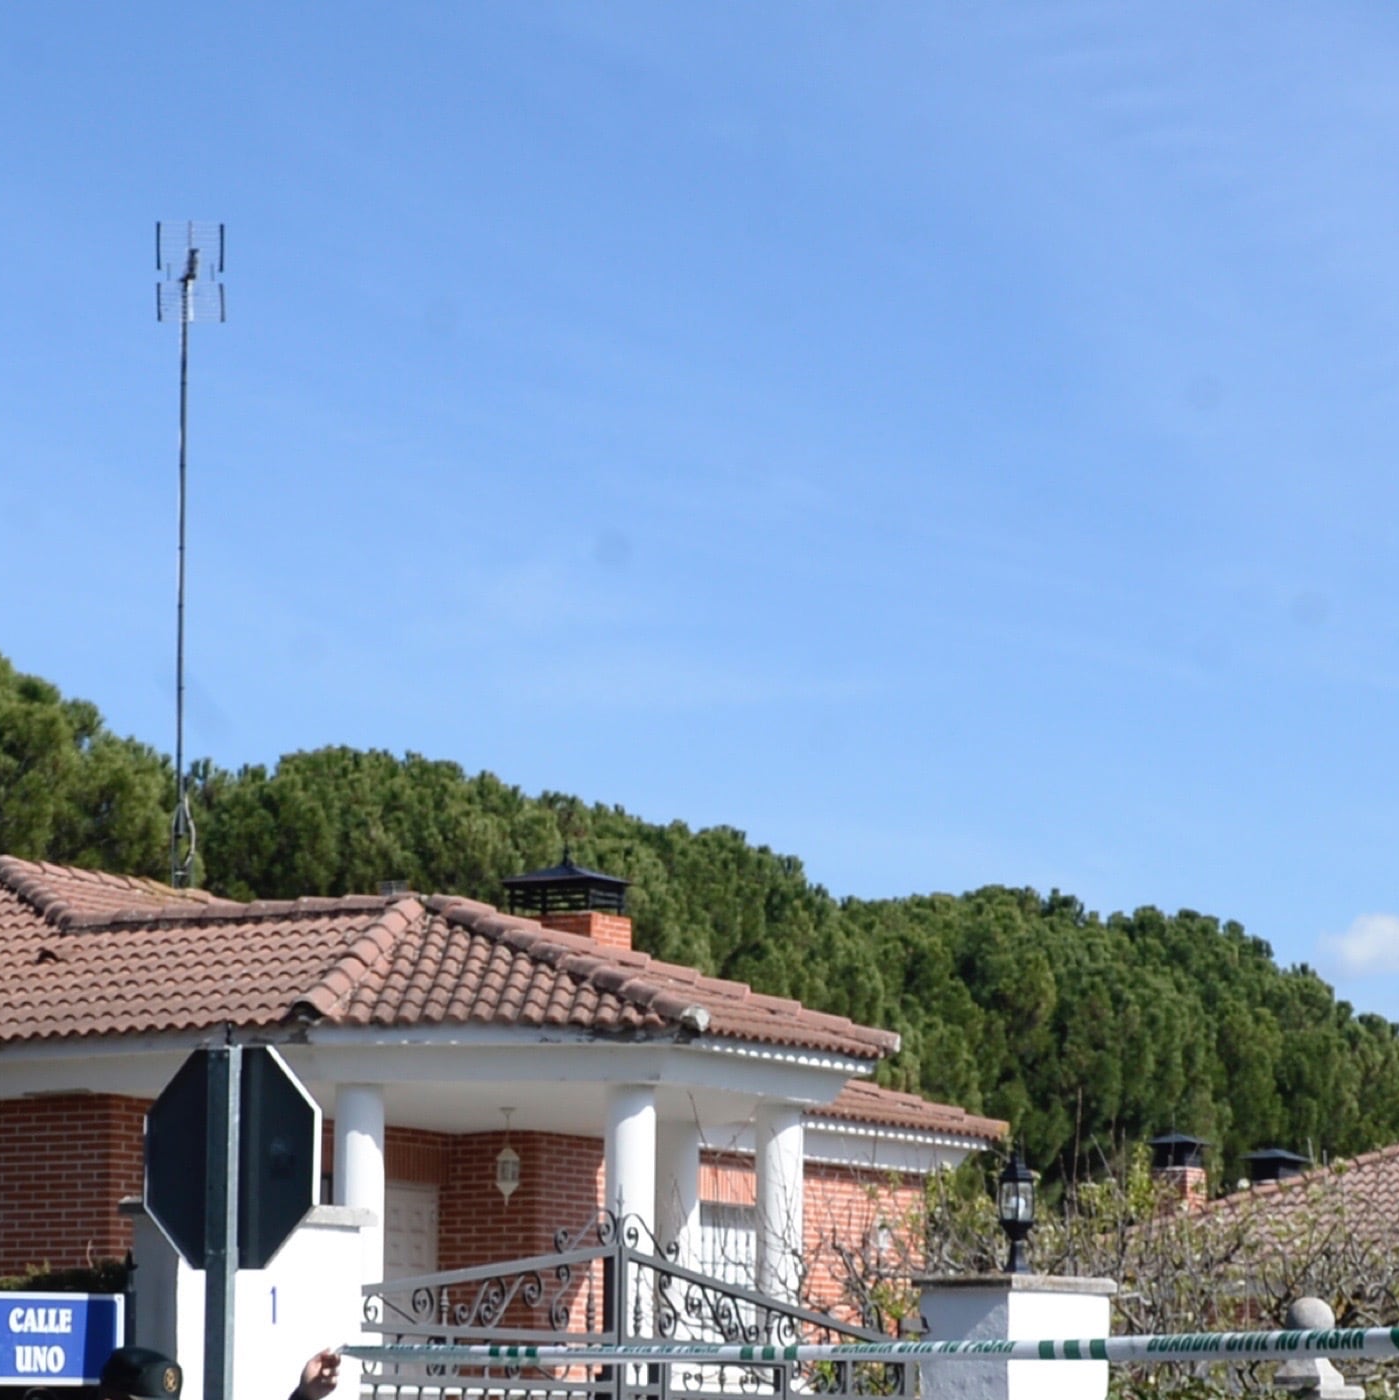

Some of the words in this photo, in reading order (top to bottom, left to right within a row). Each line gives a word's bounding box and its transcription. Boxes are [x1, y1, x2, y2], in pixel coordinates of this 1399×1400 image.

[270, 1286, 278, 1325] 1
[8, 1307, 73, 1334] CALLE
[15, 1345, 66, 1374] UNO
